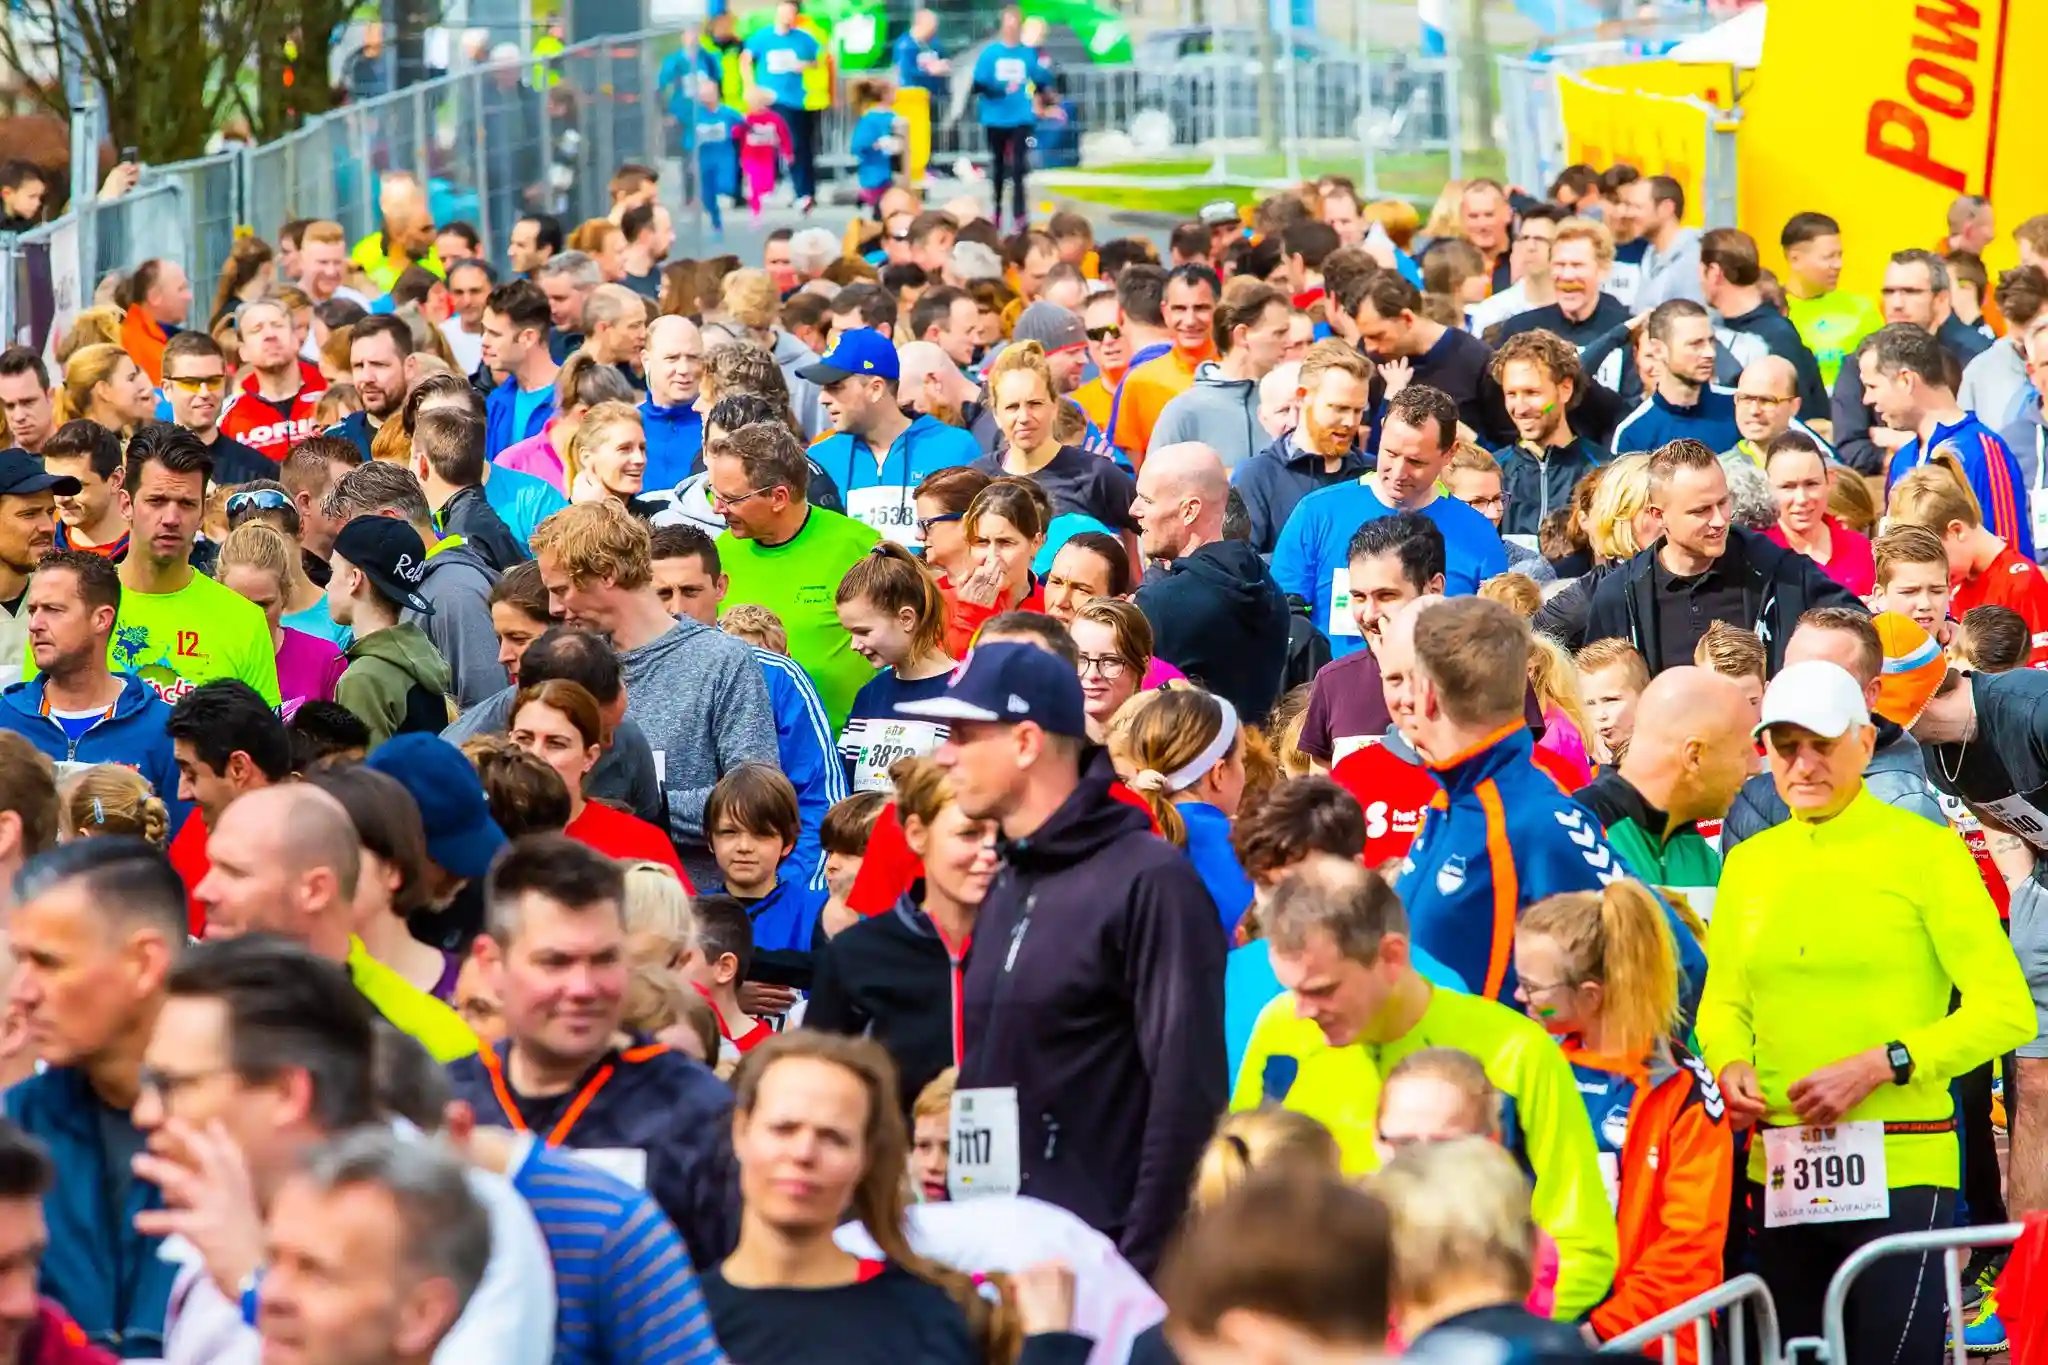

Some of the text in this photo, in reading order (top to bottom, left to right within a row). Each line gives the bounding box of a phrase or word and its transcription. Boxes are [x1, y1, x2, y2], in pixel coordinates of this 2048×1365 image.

[870, 506, 914, 526] 1538
[177, 630, 199, 657] 12
[1794, 1154, 1865, 1190] 3190
